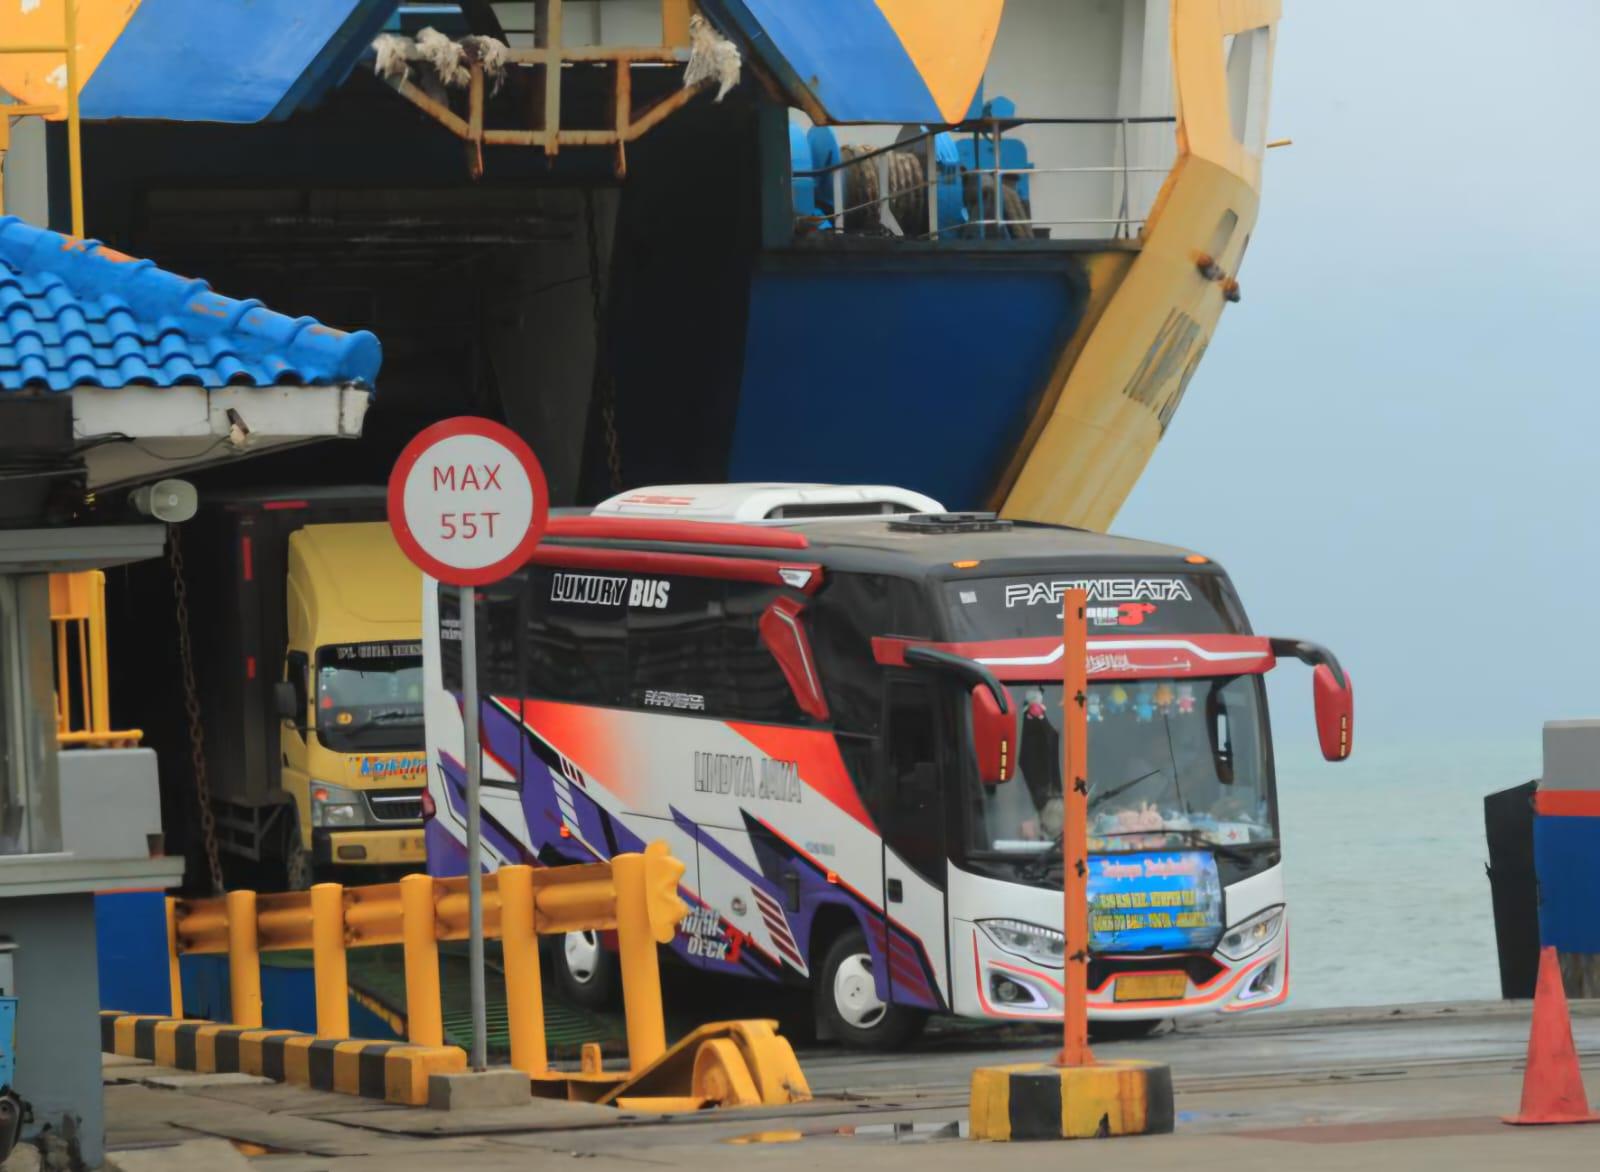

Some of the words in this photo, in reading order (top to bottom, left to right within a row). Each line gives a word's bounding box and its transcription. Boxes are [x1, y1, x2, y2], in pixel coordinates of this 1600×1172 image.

[432, 463, 502, 491] MAX
[440, 511, 501, 540] 55T
[551, 573, 628, 606] LUXURY
[628, 579, 671, 609] BUS
[694, 751, 755, 798] LINDYA
[687, 936, 728, 960] DECK
